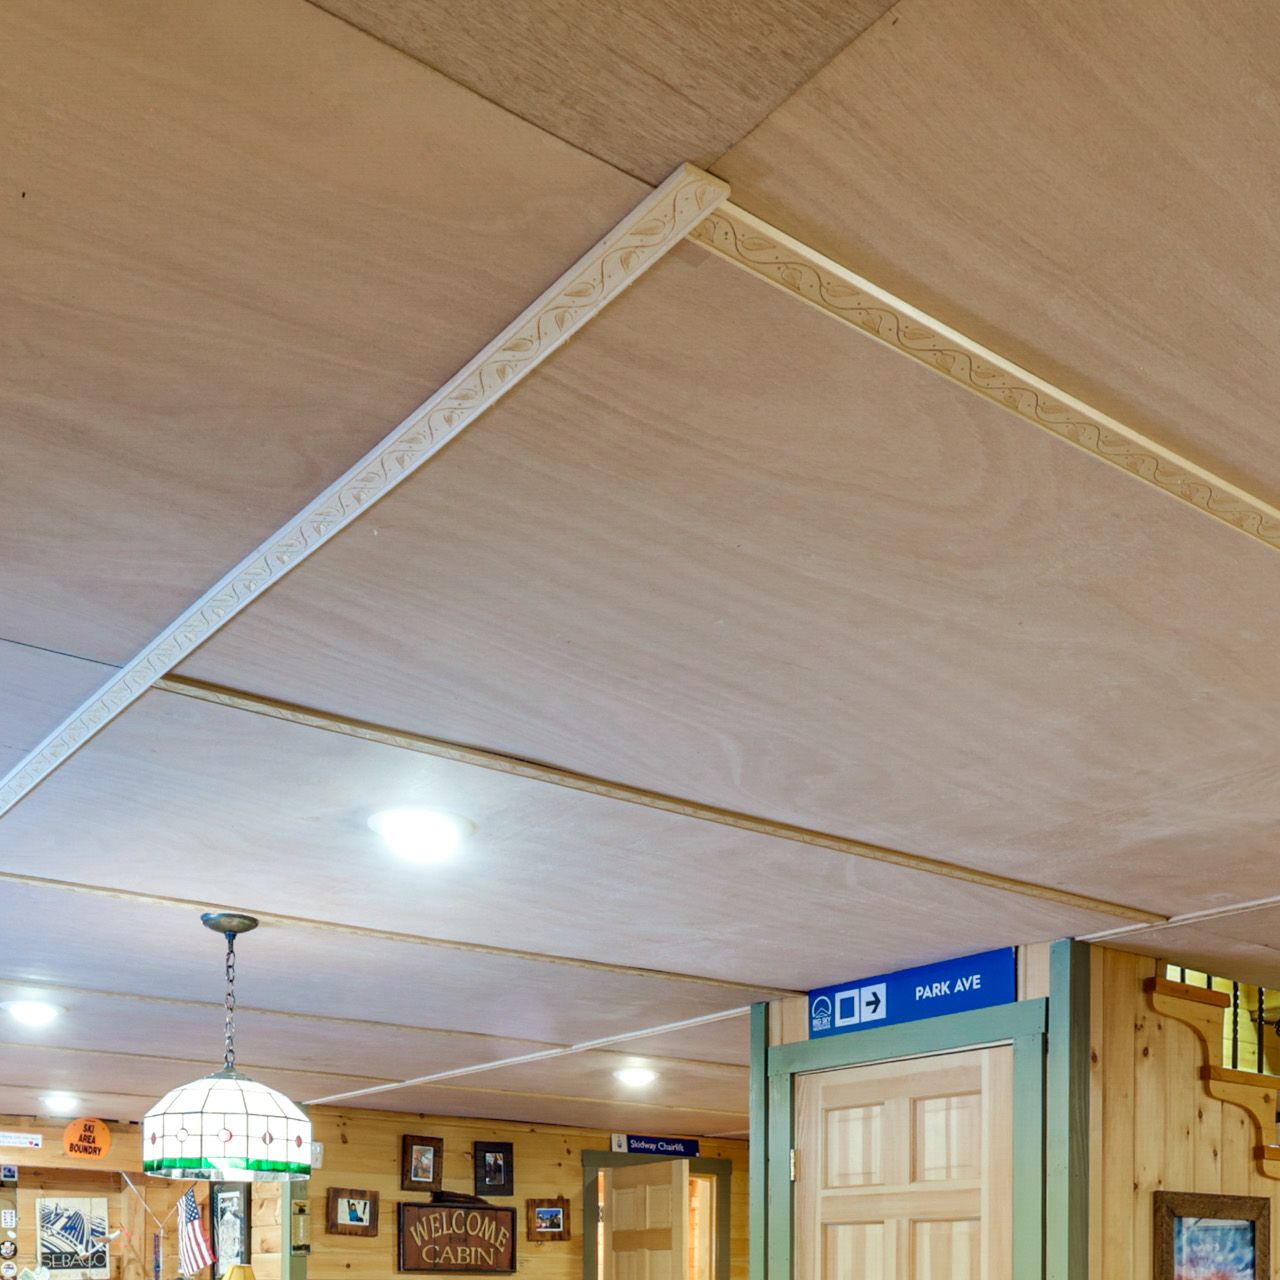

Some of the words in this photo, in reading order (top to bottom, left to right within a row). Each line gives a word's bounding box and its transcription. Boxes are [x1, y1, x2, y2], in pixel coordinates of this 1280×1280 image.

[915, 980, 950, 1000] PARK
[954, 974, 981, 993] AVE
[83, 1123, 95, 1133] SKI
[78, 1133, 96, 1145] AREA
[630, 1139, 656, 1151] Skidway
[658, 1142, 685, 1152] Chairlift
[69, 1143, 103, 1156] BOUNDRY
[410, 1210, 510, 1253] WELCOME
[422, 1244, 495, 1265] CABIN
